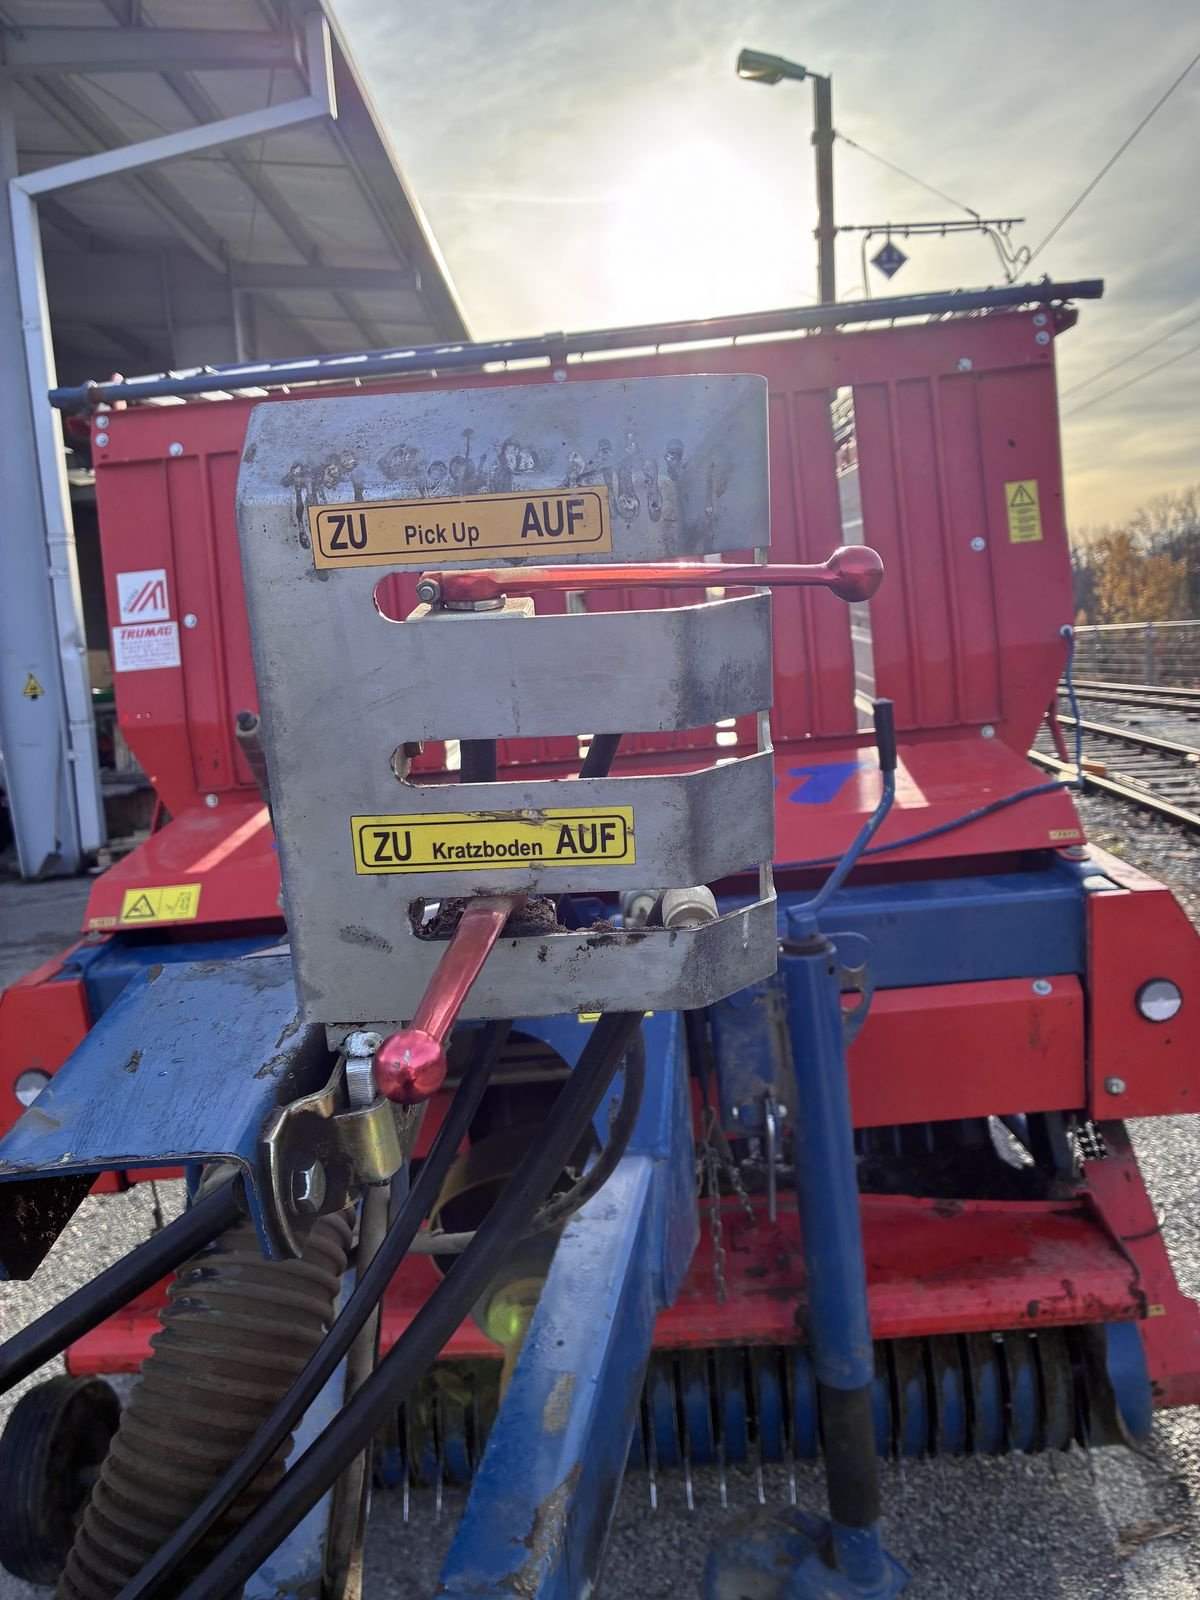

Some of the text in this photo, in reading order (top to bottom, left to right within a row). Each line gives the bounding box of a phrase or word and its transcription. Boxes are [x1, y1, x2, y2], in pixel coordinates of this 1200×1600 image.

[327, 499, 585, 550] ZU Pick Up AUF
[373, 823, 616, 862] ZU Kratzboden AUF
